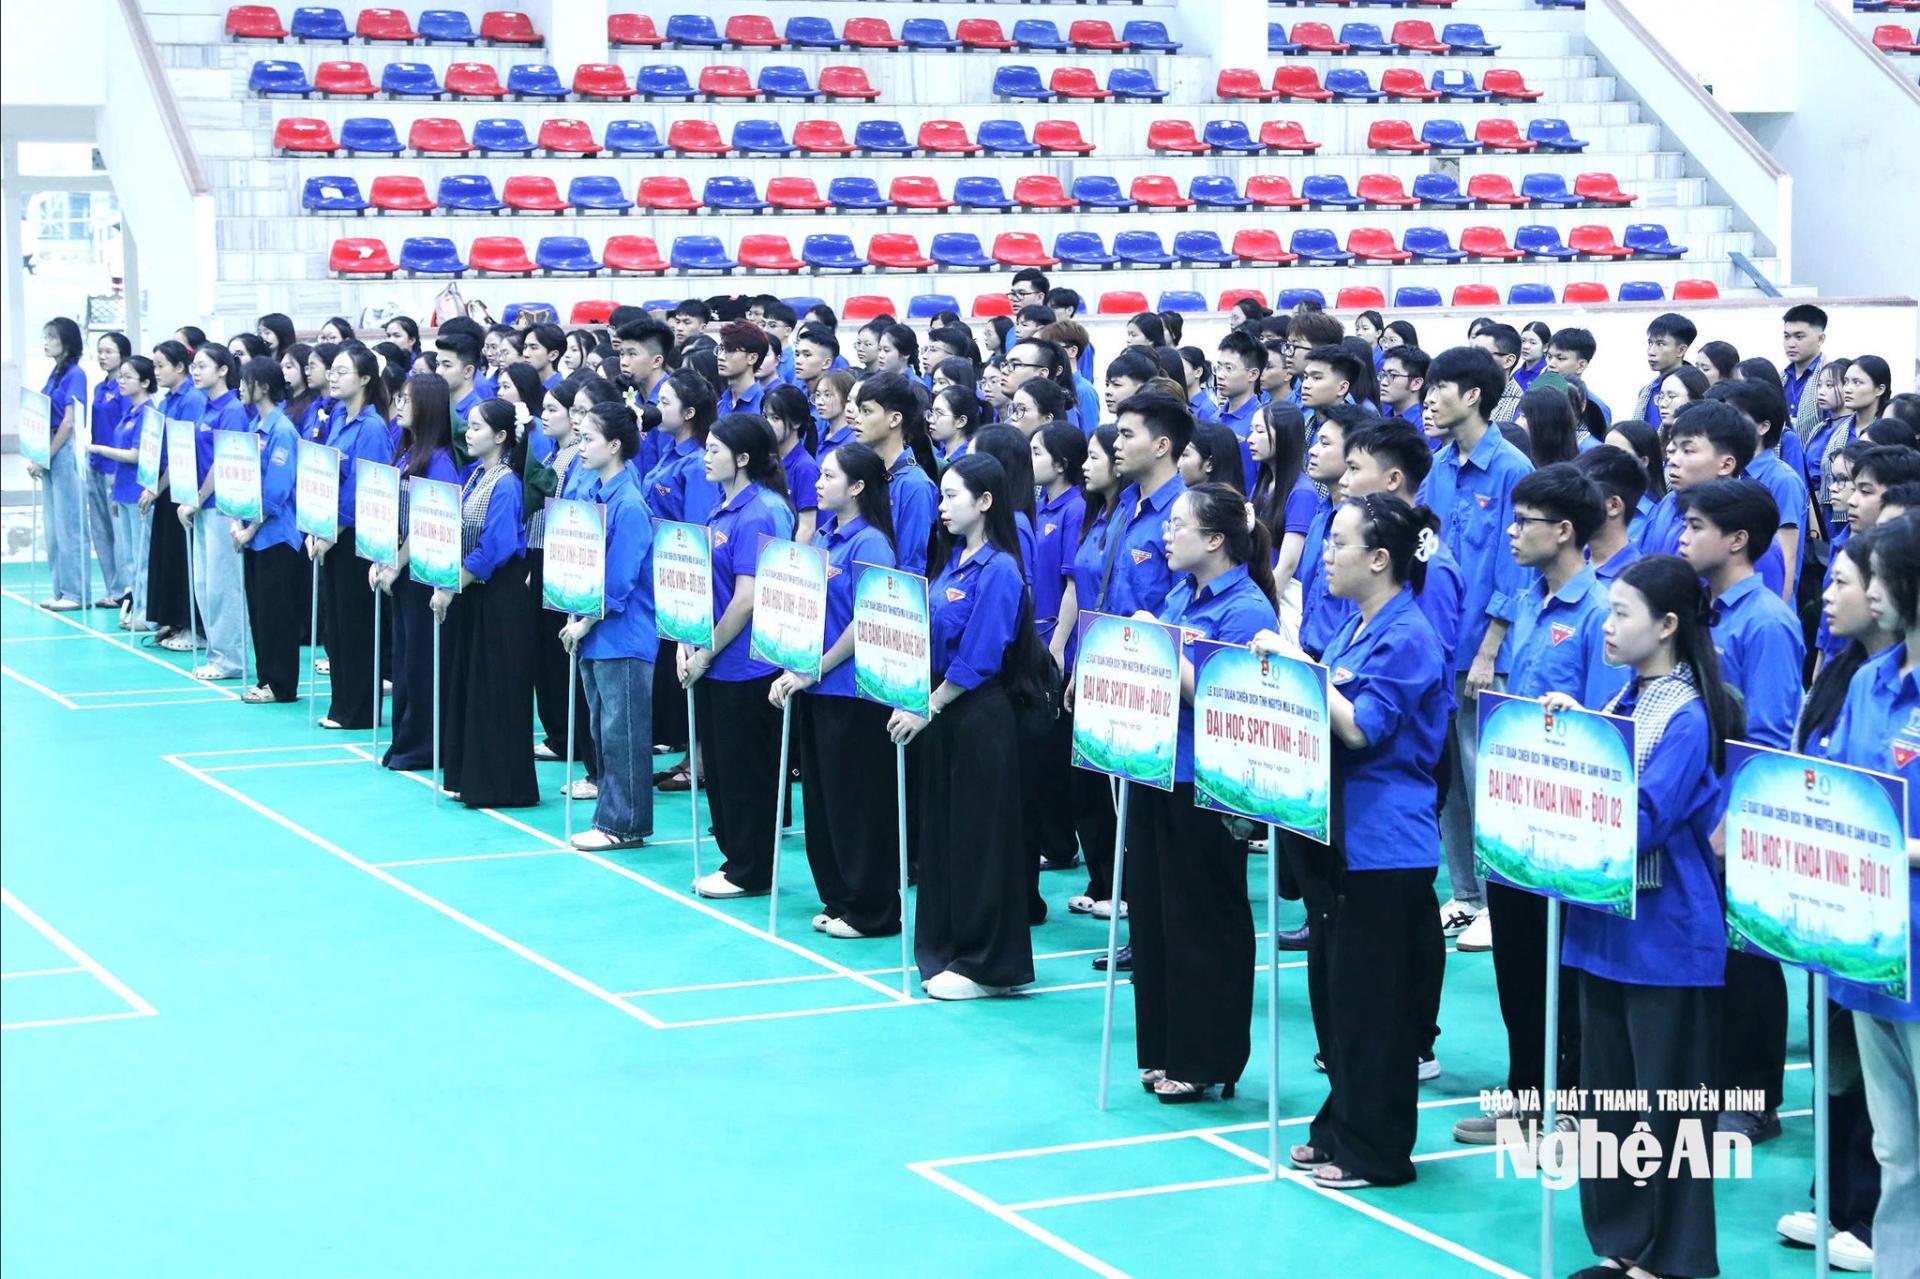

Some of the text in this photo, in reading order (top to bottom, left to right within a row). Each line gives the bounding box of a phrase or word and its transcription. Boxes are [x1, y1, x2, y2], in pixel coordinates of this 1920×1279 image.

[1083, 675, 1096, 704] ĐẠI
[1096, 677, 1110, 707] HỌC
[1111, 681, 1128, 707] SPKT
[1129, 684, 1146, 711] VINH
[1150, 684, 1164, 720] ĐỘI
[1163, 691, 1172, 718] 02
[1207, 708, 1223, 742] ĐẠI
[1226, 712, 1245, 747] HỌC
[1248, 717, 1270, 748] SPKT
[1273, 723, 1292, 753] VINH
[1299, 726, 1311, 765] ĐỘI
[1312, 735, 1320, 763] 01
[1489, 769, 1504, 805] ĐẠI
[1506, 773, 1523, 810] HỌC
[1526, 778, 1532, 807] Y
[1534, 779, 1557, 813] KHOA
[1561, 785, 1583, 819] VINH
[1592, 786, 1608, 831] ĐỘI
[1611, 796, 1622, 828] 02
[1742, 828, 1759, 870] ĐẠI
[1762, 833, 1782, 876] HỌC
[1785, 839, 1792, 872] Y
[1794, 841, 1822, 880] KHOA
[1826, 850, 1850, 887] VINH
[1860, 852, 1877, 902] ĐỘI
[1880, 864, 1892, 899] 01
